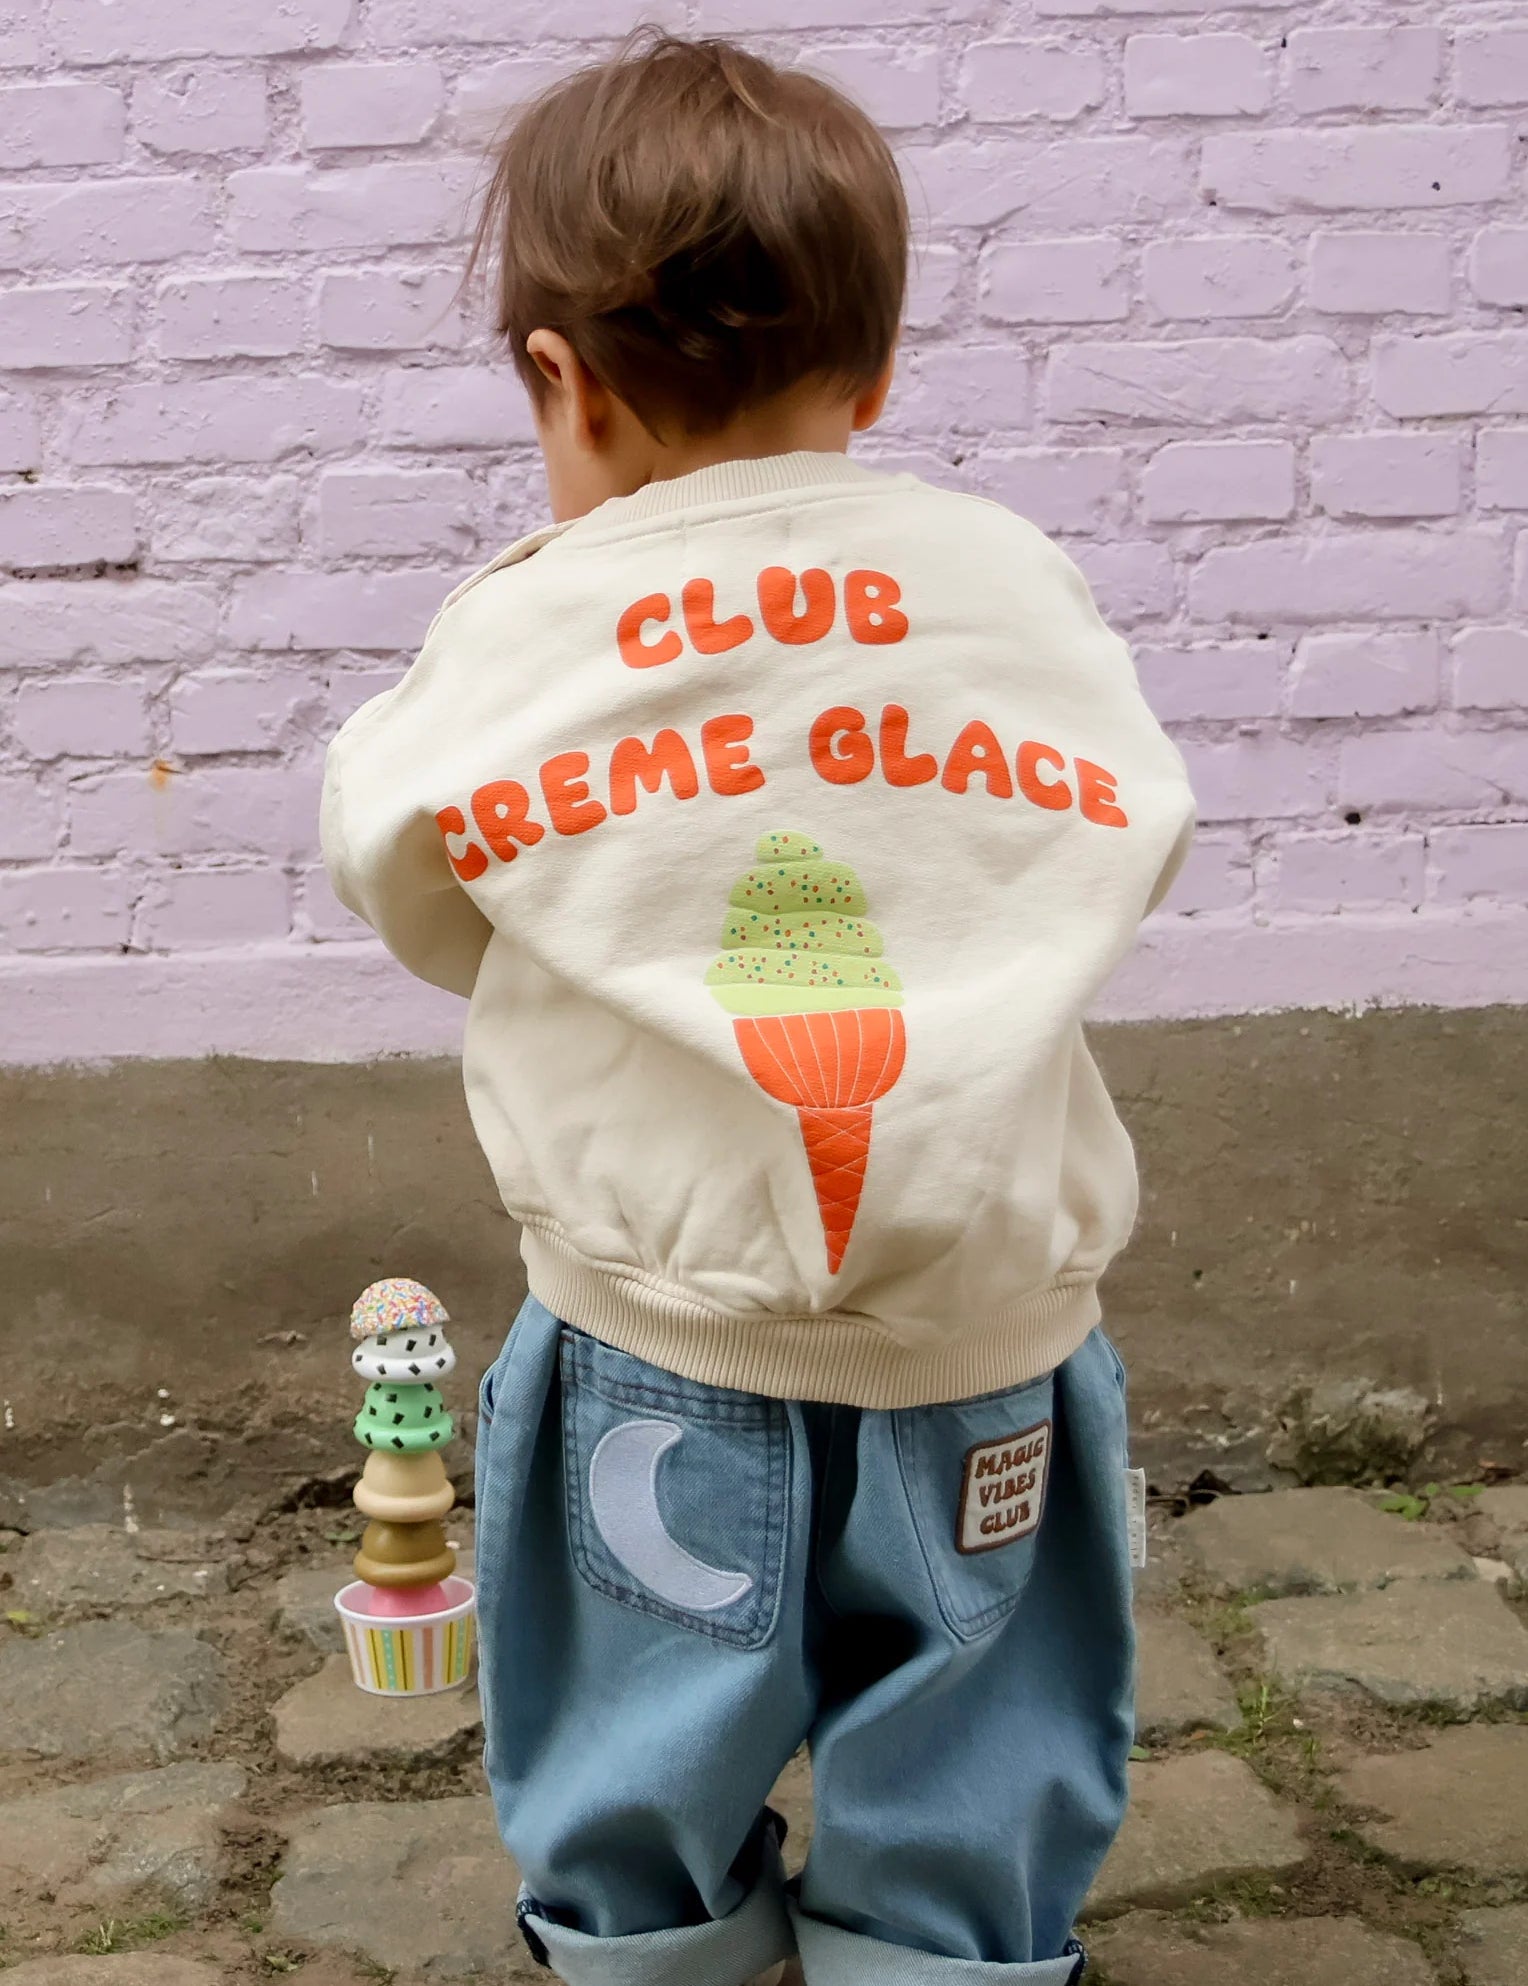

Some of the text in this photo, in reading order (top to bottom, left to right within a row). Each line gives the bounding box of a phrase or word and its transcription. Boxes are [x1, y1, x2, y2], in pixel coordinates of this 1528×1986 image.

[616, 565, 910, 669] CLUB
[435, 704, 1129, 882] CREME GLACE
[975, 1437, 1044, 1479] MAGIC
[979, 1468, 1036, 1507] VIBES
[980, 1500, 1030, 1534] CLUB
